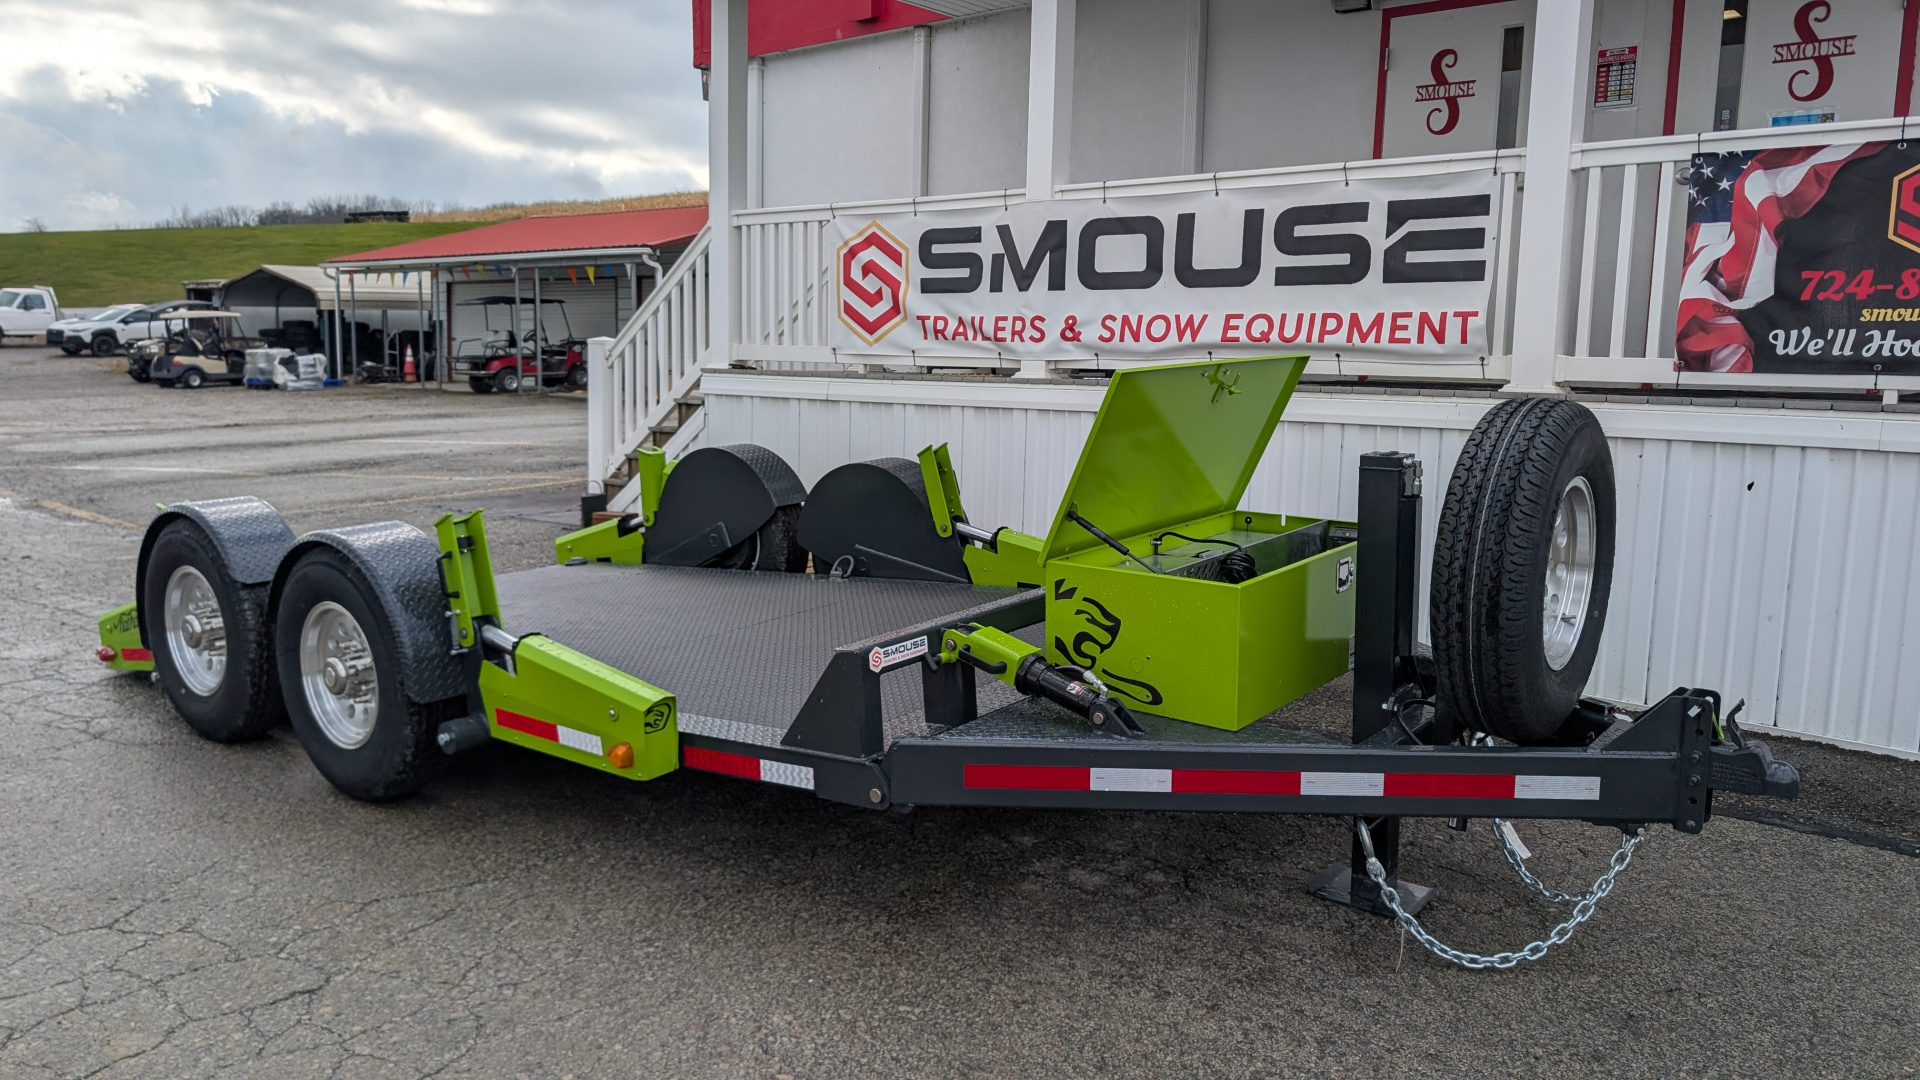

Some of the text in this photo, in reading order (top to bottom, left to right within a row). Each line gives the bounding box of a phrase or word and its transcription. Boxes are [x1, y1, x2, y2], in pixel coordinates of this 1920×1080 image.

[1773, 37, 1856, 62] SMOUSE
[1416, 82, 1475, 100] SMOUSE
[918, 193, 1491, 295] SMOUSE
[1800, 268, 1920, 302] 724-8
[916, 310, 1479, 345] TRAILERS & SNOW EQUIPMENT
[1768, 326, 1857, 356] We'll
[882, 638, 926, 658] SMOUSE
